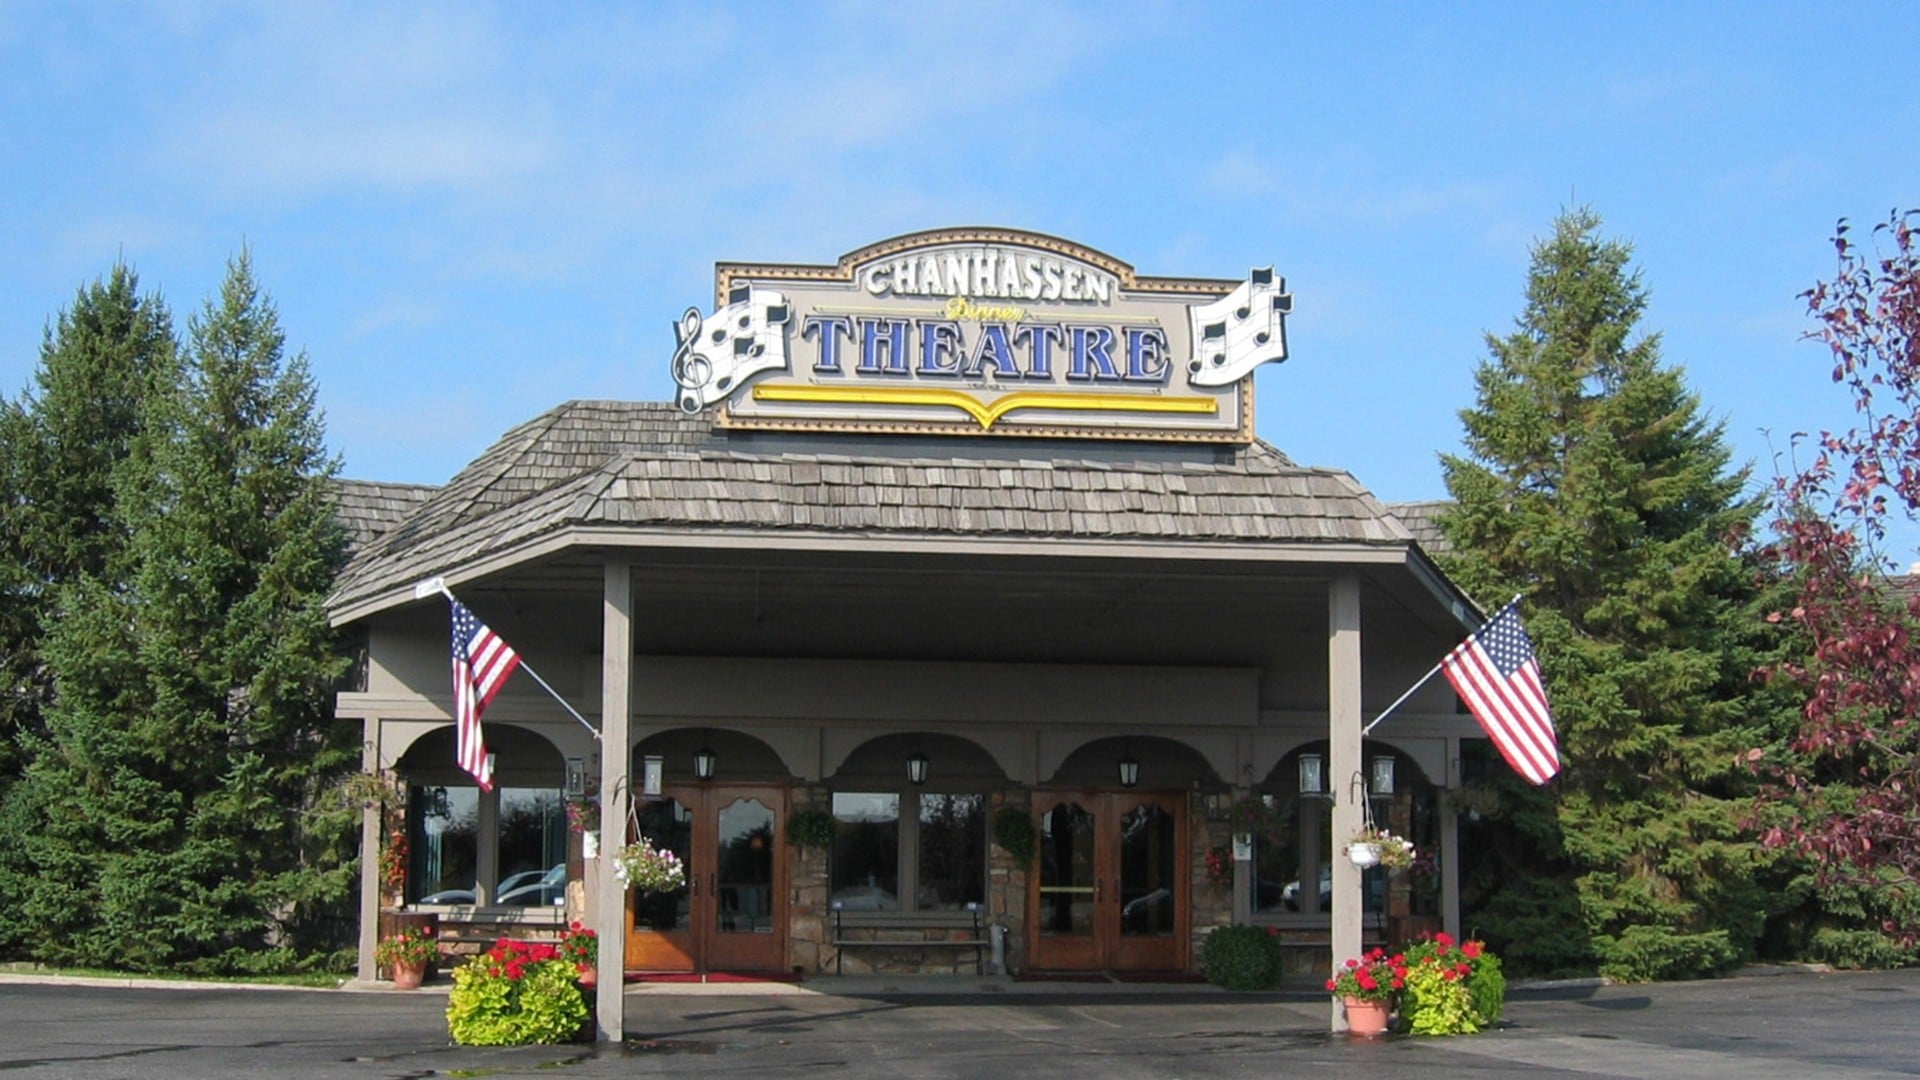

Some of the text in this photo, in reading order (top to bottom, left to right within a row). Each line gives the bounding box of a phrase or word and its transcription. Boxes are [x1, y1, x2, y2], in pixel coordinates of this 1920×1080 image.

[865, 248, 1115, 301] CHANHASSEN
[945, 297, 1025, 321] Dinner
[802, 315, 1171, 383] THEATRE
